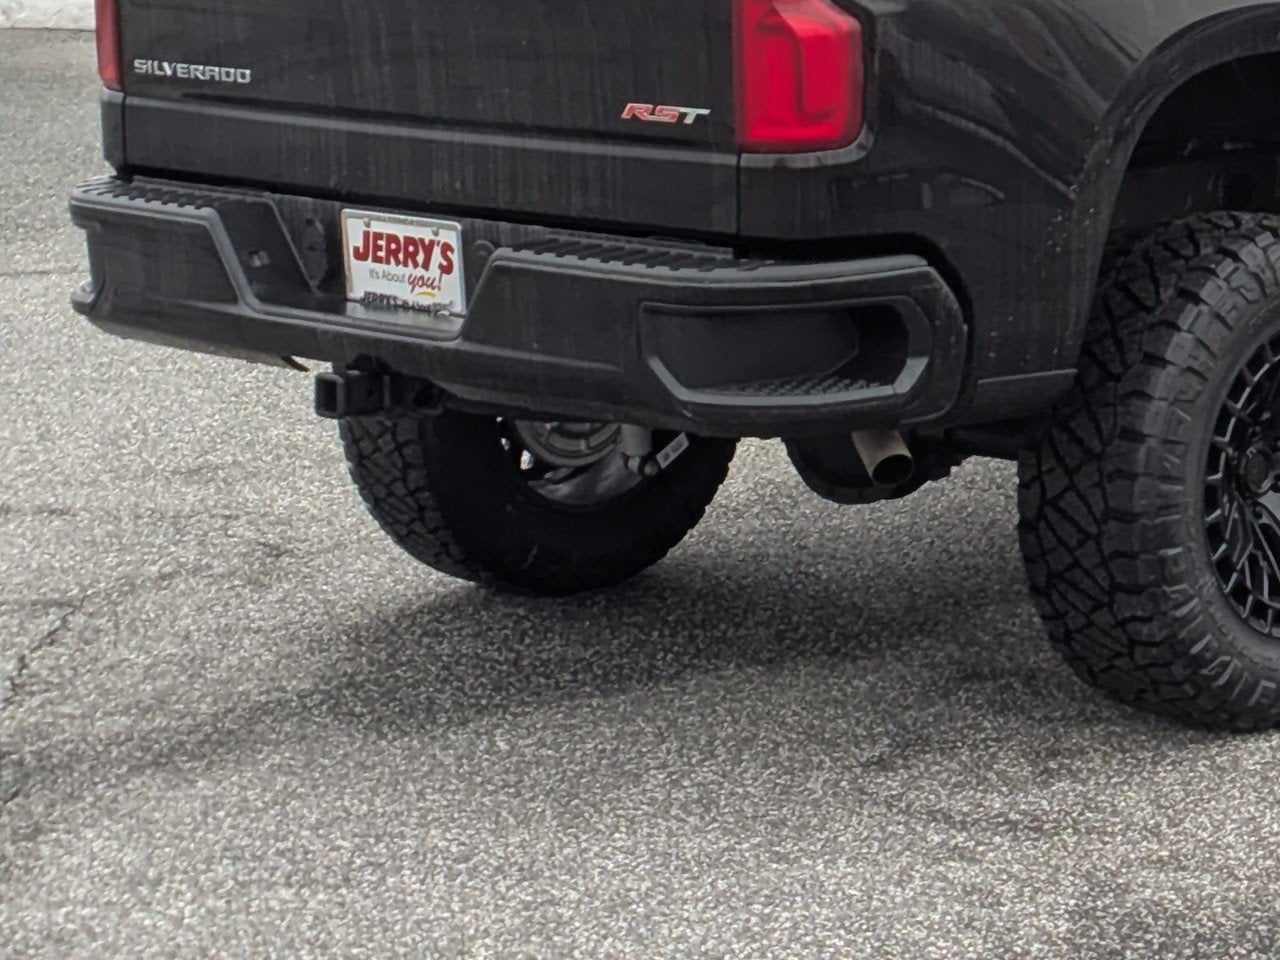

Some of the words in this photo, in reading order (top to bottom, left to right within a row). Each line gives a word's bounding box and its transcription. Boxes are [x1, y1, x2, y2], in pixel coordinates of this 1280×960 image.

[133, 58, 252, 84] SILVERADO
[621, 102, 711, 125] RST
[352, 229, 455, 275] JERRY'S
